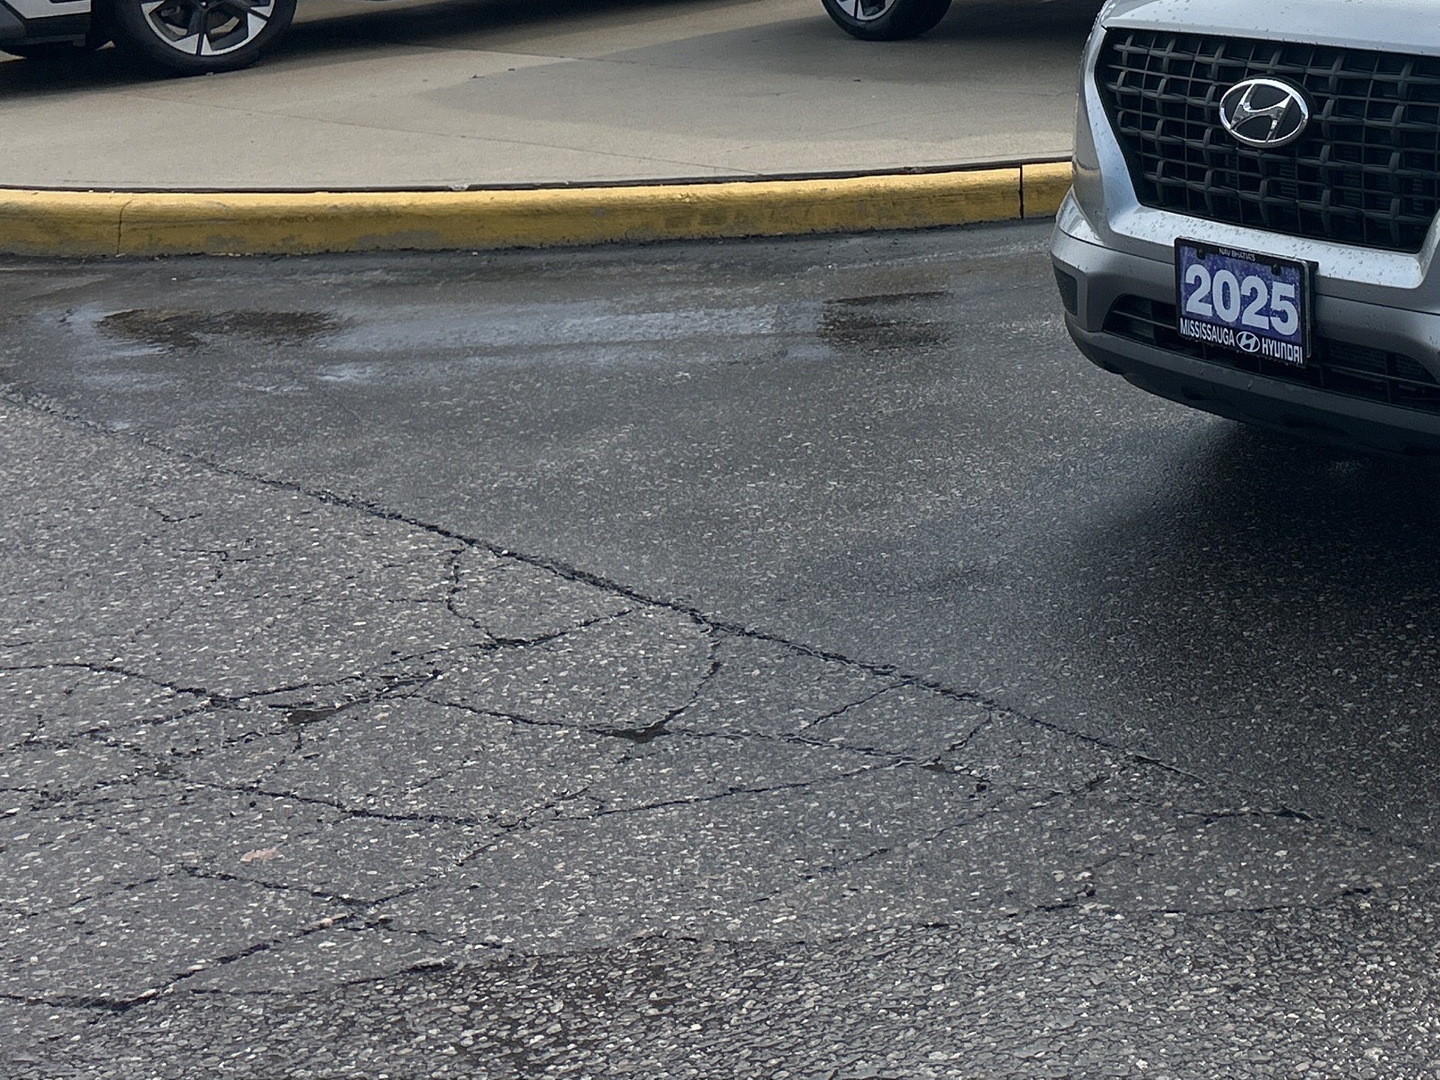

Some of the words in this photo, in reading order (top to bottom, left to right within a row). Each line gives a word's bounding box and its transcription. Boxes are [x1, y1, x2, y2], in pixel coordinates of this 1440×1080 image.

[1185, 263, 1299, 336] 2025
[1179, 318, 1236, 347] MISSISSAUGA
[1262, 337, 1304, 364] HYUNDAI
